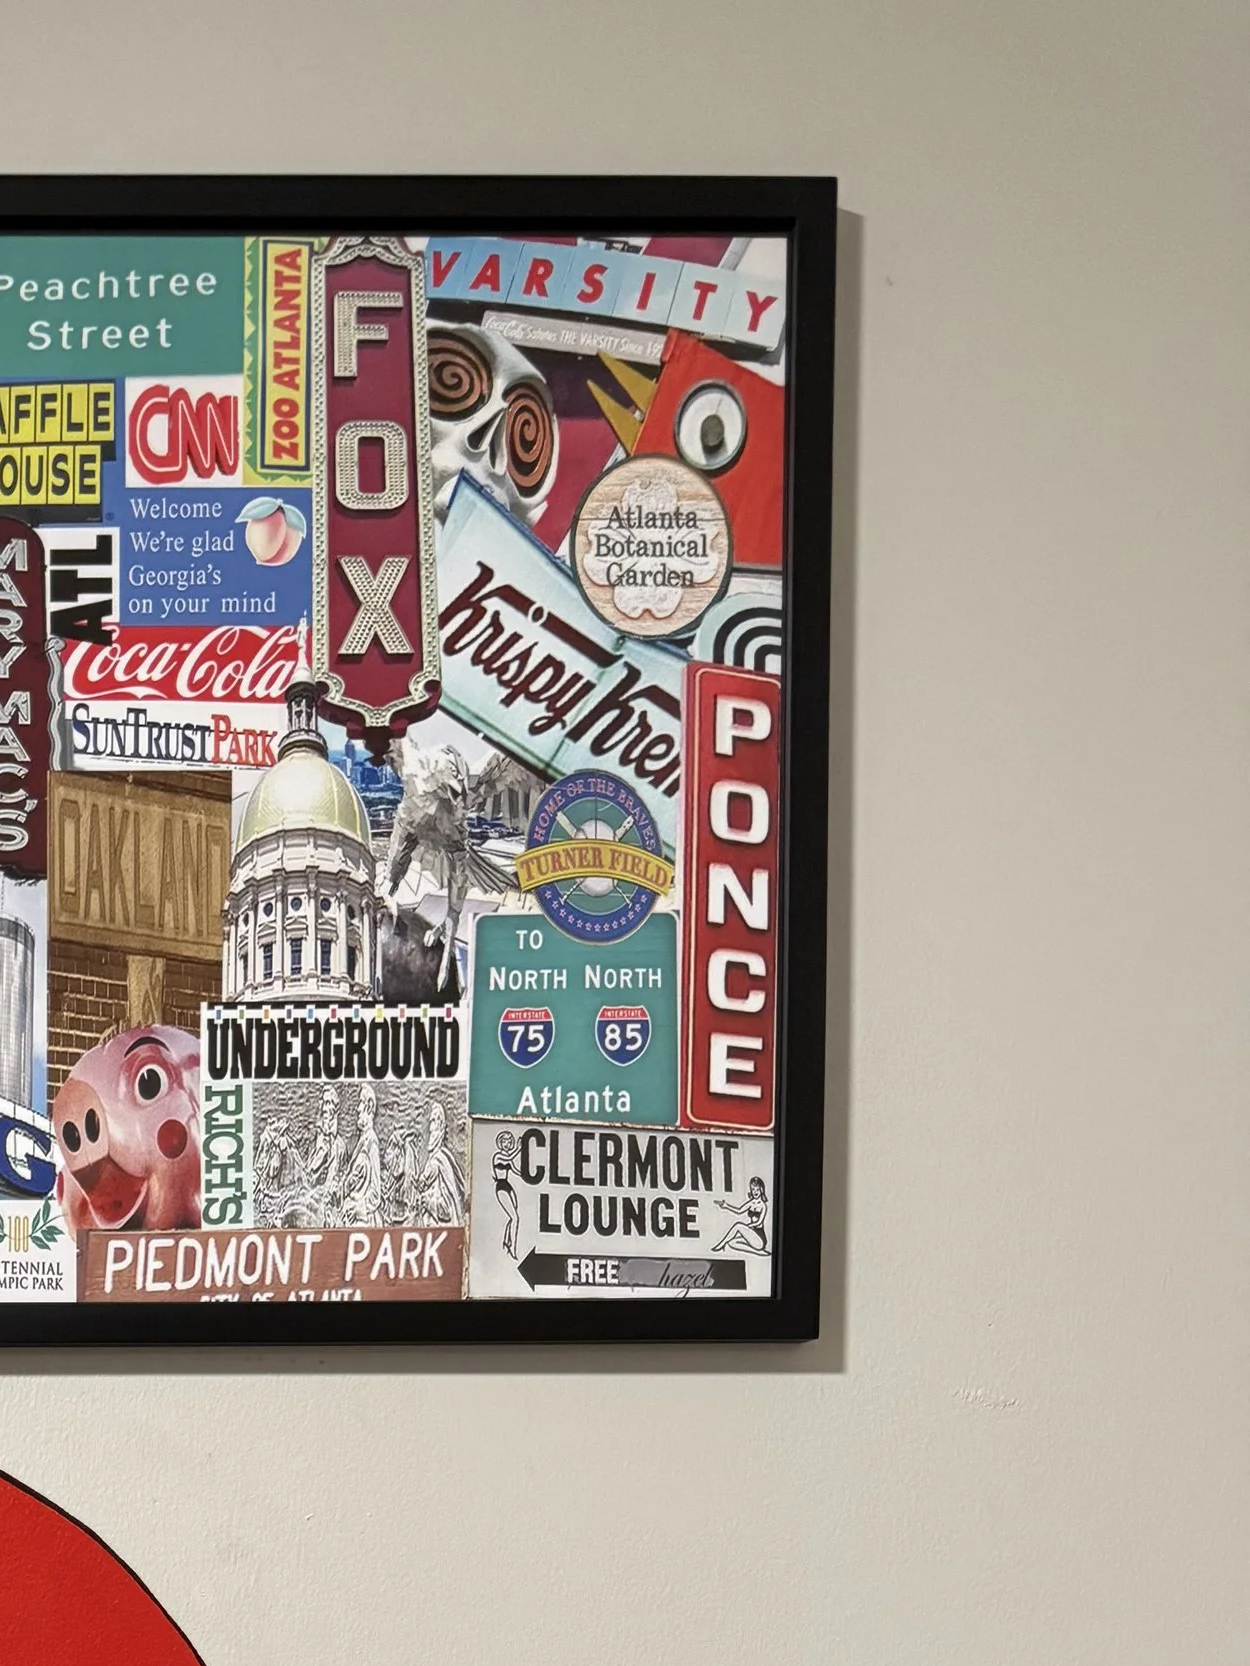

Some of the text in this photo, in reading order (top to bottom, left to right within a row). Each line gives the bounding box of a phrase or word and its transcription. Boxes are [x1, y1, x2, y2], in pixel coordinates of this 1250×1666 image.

[432, 250, 779, 333] VARSITY
[27, 317, 173, 351] Street
[579, 332, 620, 351] VARSITY
[272, 247, 302, 462] ZOO ATLANTA
[128, 384, 240, 485] CNN
[333, 291, 414, 655] FOX
[129, 498, 222, 518] Welcome
[604, 505, 699, 530] Atlanta
[129, 531, 235, 557] We're glad
[594, 534, 708, 559] Botanical
[128, 564, 222, 591] Georgia's
[606, 562, 695, 588] Garden
[51, 534, 114, 647] ATL
[128, 591, 276, 619] on your mind
[63, 624, 309, 700] Coca-Cola
[438, 560, 624, 736] Krispy
[534, 778, 656, 851] HOME OF THE BRAVES
[58, 797, 226, 937] OAKLAND
[521, 846, 669, 888] TURNER FIELD
[707, 693, 772, 1099] PONCE
[515, 930, 543, 950] TO
[489, 964, 662, 991] NORTH NORTH
[508, 1010, 546, 1020] INTERSTATE
[604, 1009, 642, 1019] INTERSTATE
[206, 1015, 460, 1081] UNDERGROUND
[507, 1024, 546, 1053] 75
[604, 1023, 643, 1052] 85
[516, 1085, 632, 1115] Atlanta
[519, 1127, 740, 1193] CLERMONT
[539, 1192, 701, 1239] LOUNGE
[104, 1230, 449, 1294] PIEDMONT PARK
[566, 1258, 620, 1285] FREE
[32, 1275, 64, 1291] PARK
